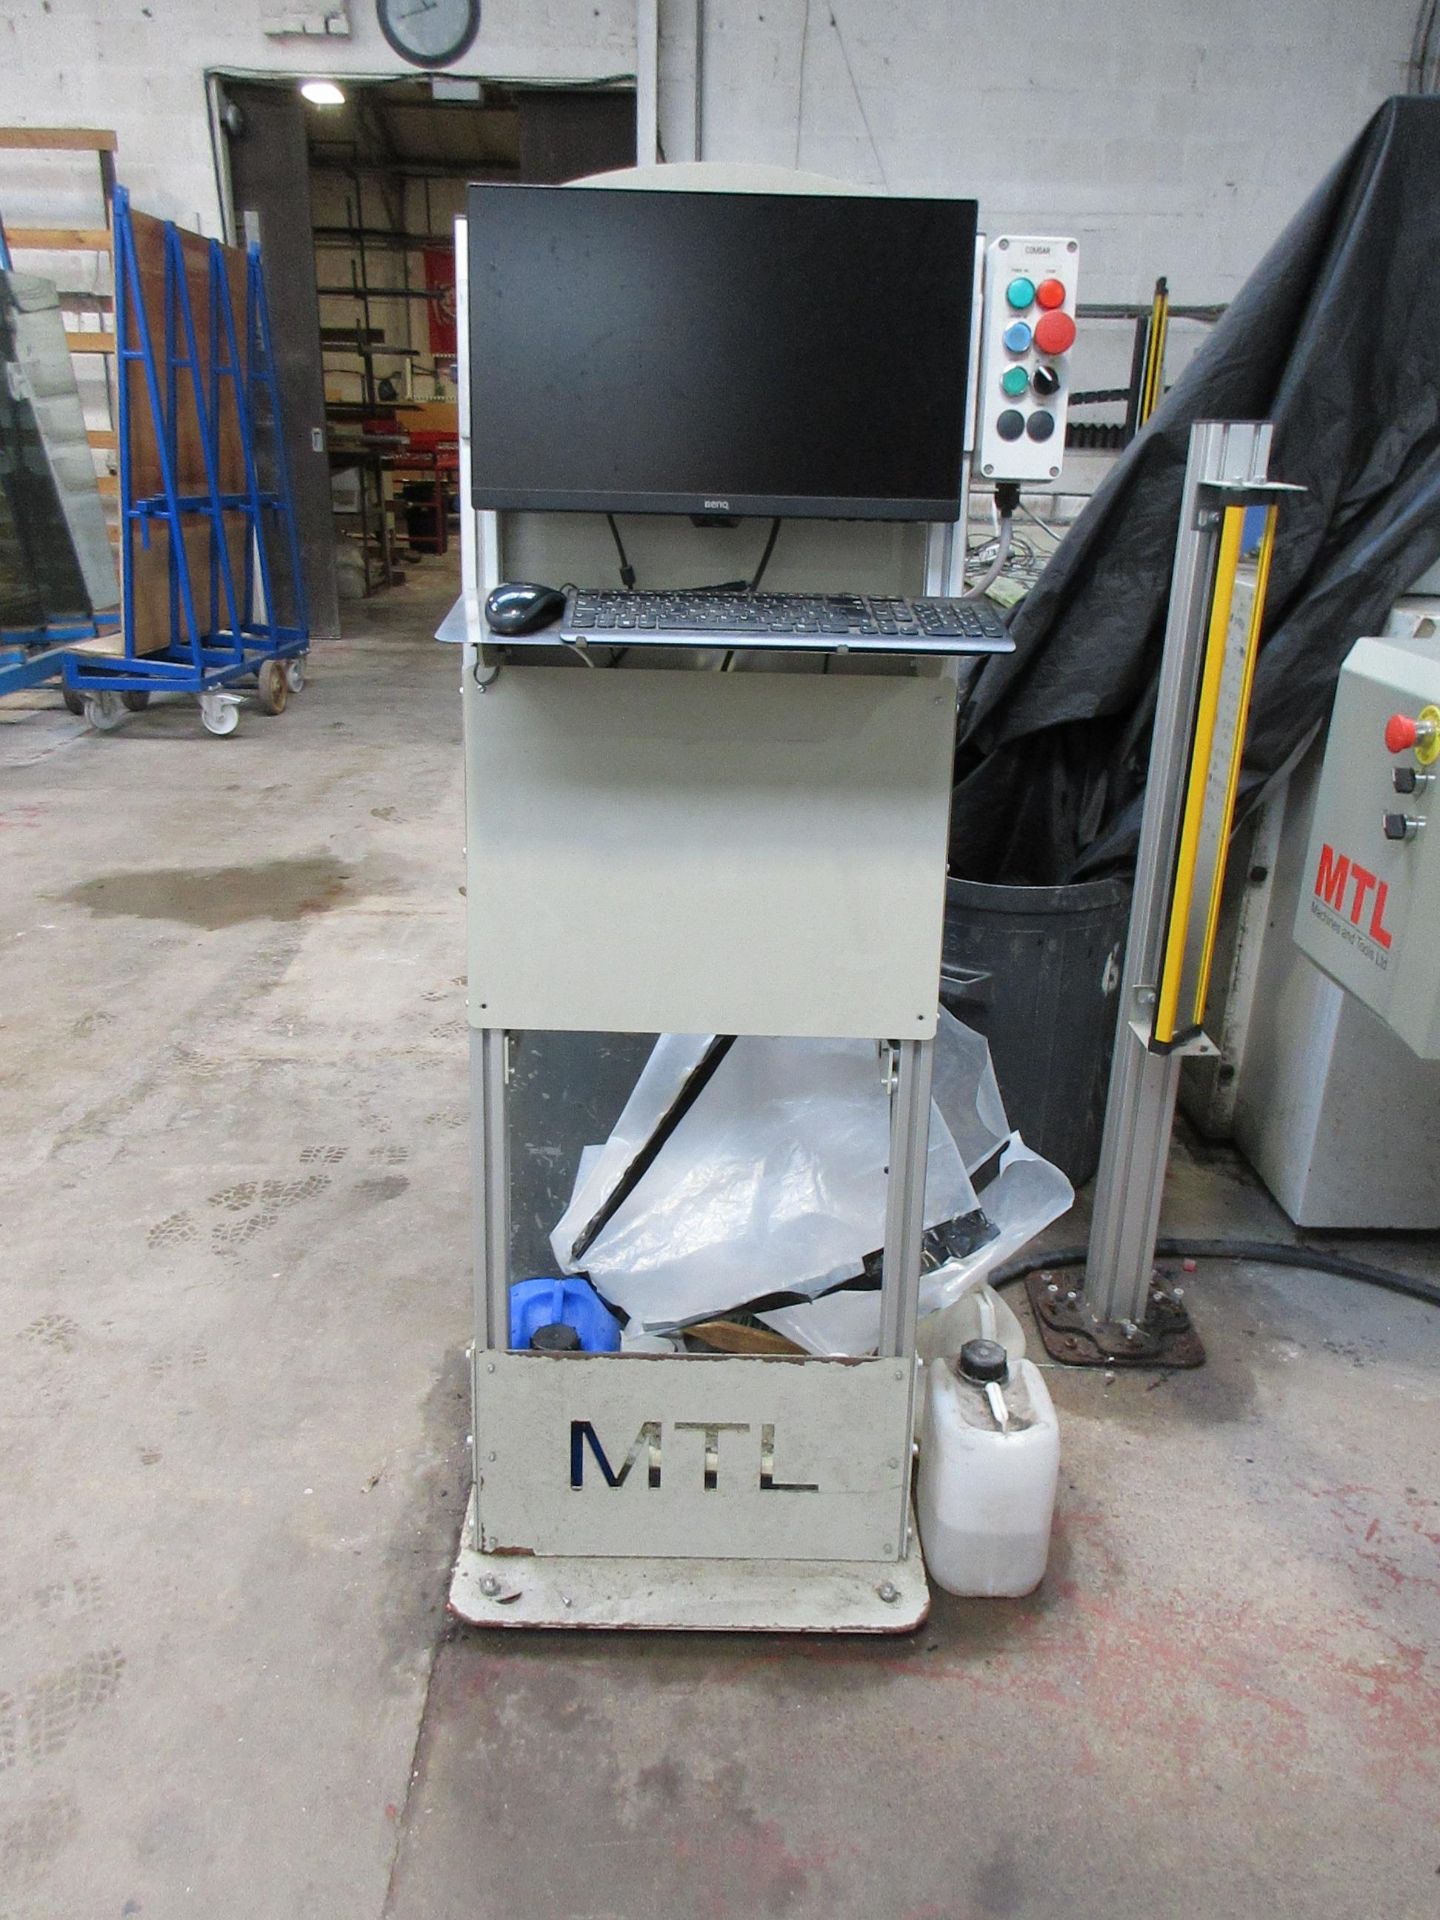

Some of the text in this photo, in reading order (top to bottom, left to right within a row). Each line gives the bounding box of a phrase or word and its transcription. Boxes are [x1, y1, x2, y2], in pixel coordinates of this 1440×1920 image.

[1025, 245, 1051, 255] COUGAR
[1314, 843, 1393, 950] MTL
[570, 1420, 819, 1491] MTL
